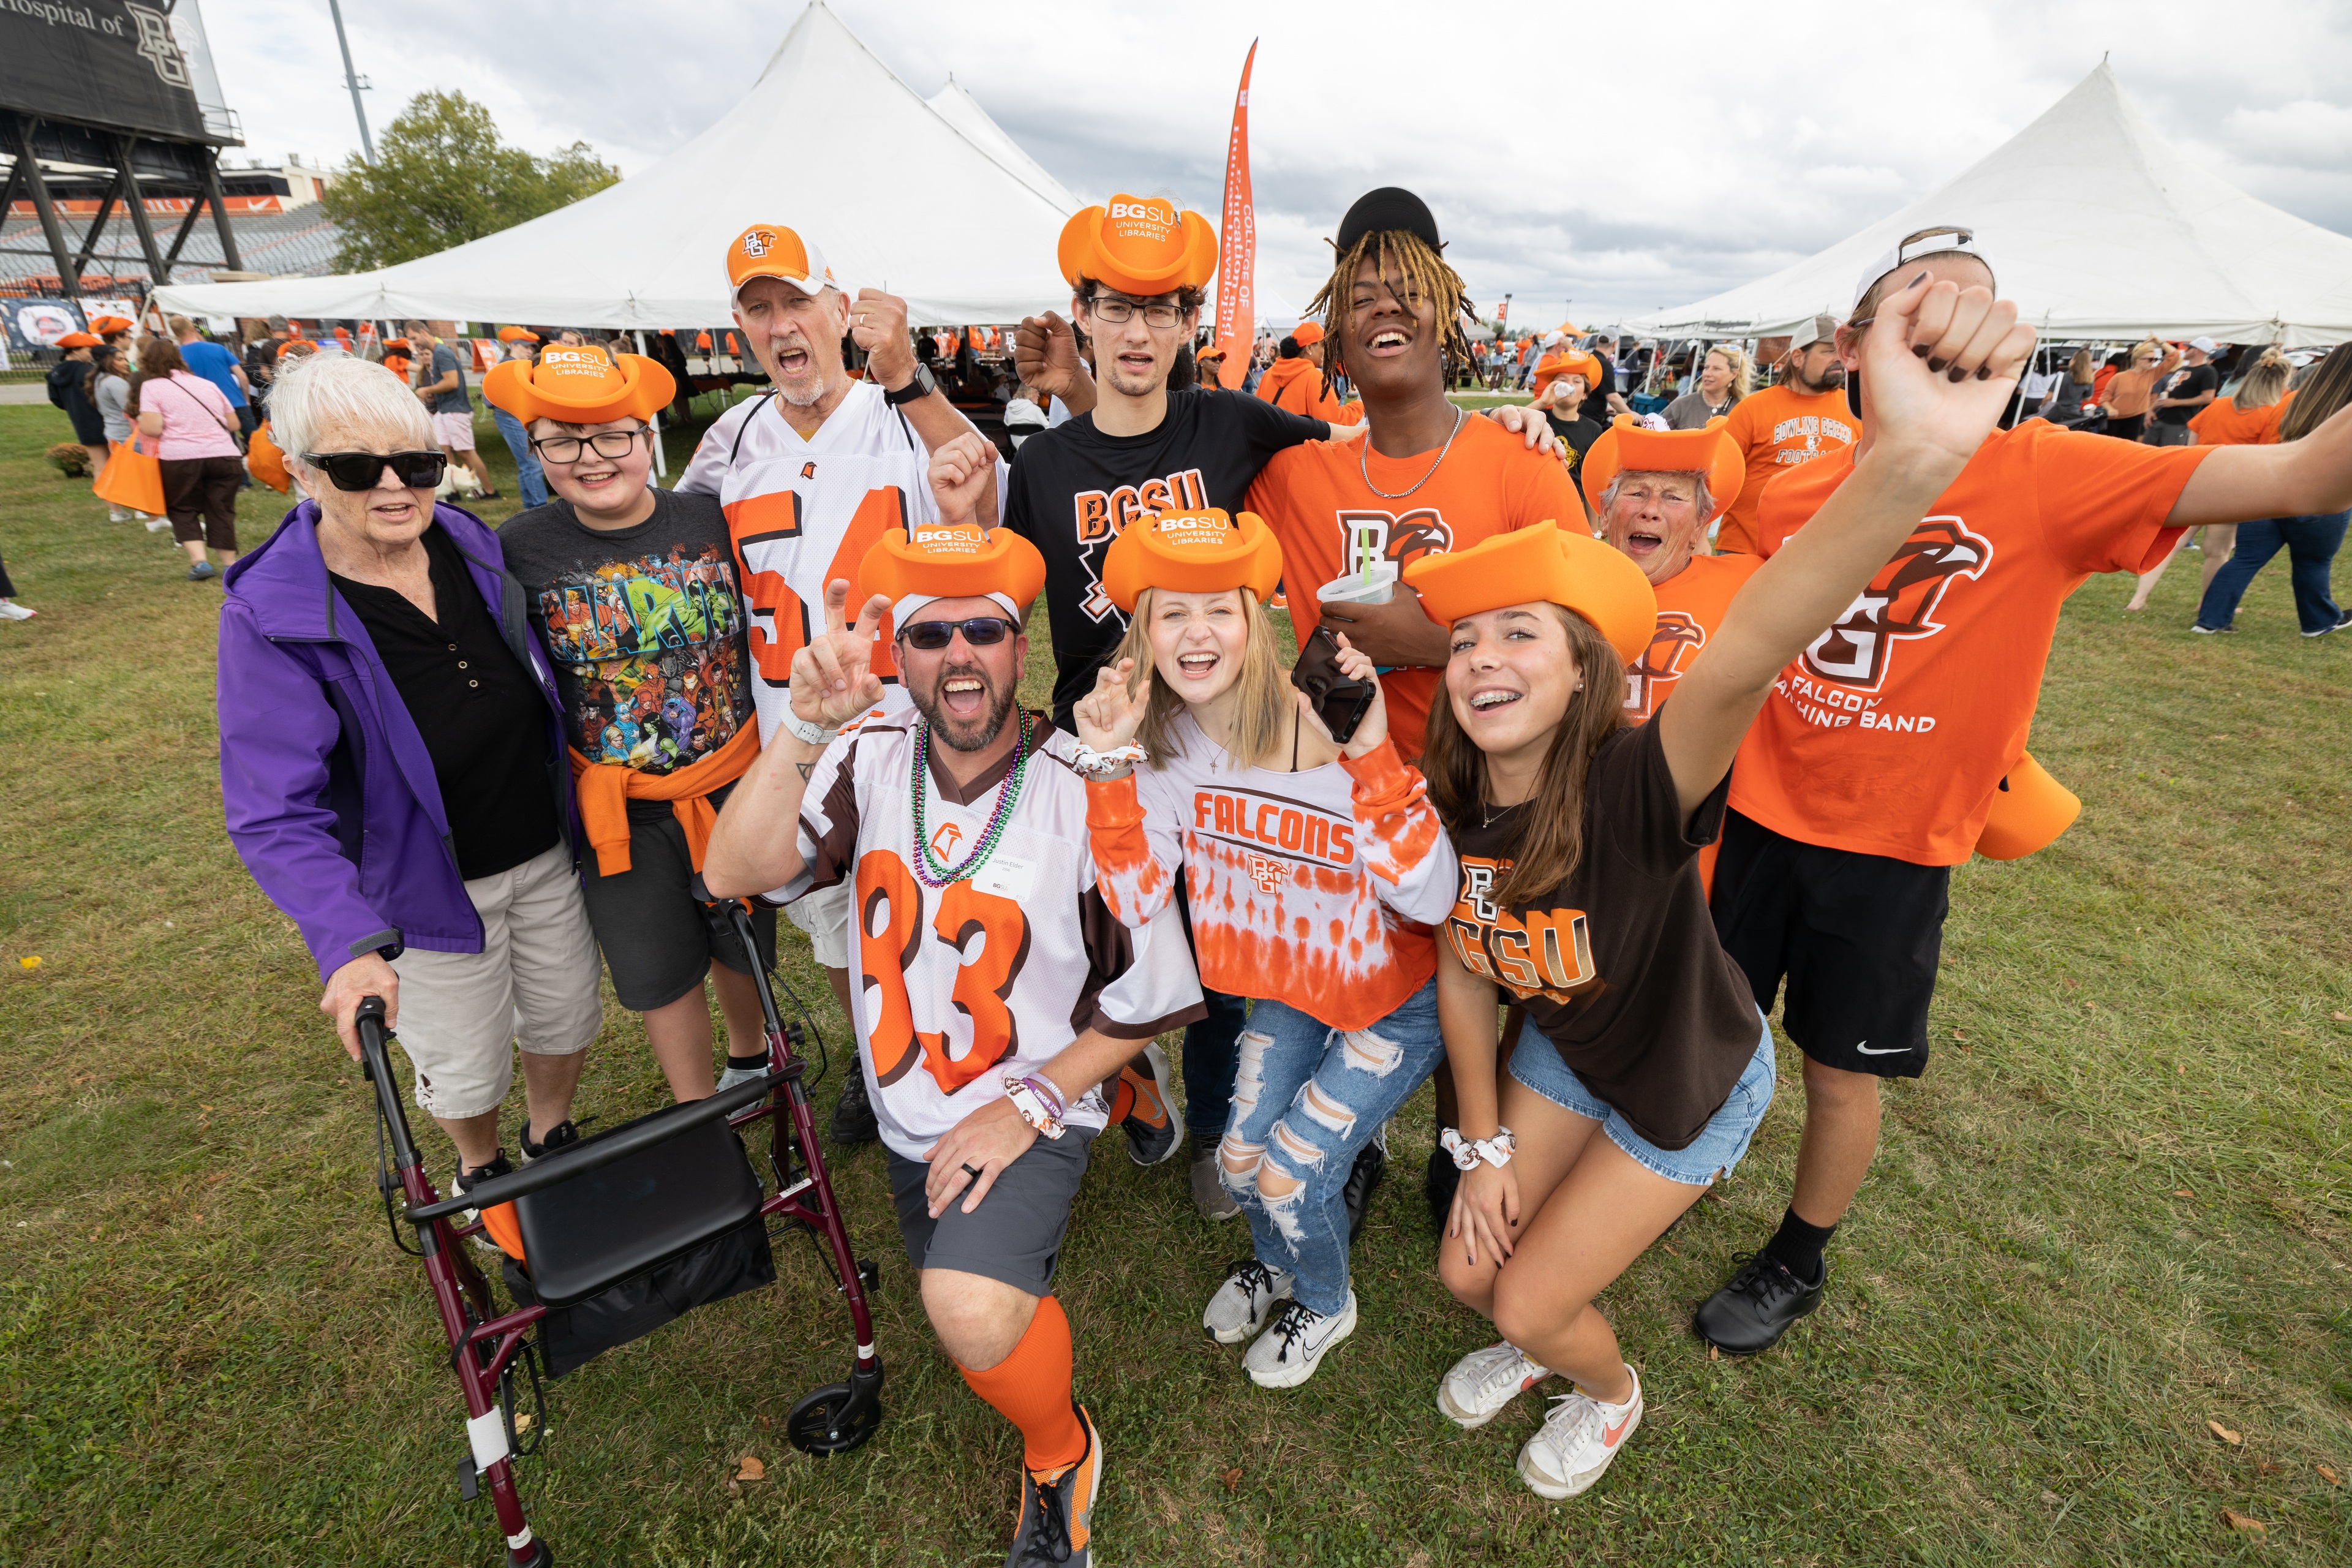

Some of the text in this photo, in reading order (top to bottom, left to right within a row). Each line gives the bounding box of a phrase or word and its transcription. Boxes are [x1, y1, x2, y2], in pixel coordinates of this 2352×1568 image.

[100, 15, 124, 37] of
[1111, 203, 1174, 225] BGSU
[1115, 221, 1170, 235] UNIVERSITY
[1119, 230, 1166, 242] LIBRARIES
[1239, 204, 1253, 308] COLLEGE OF
[1224, 294, 1235, 337] and
[545, 351, 609, 367] BGSU
[551, 363, 608, 372] UNIVERSITY
[556, 369, 605, 378] LIBRARIES
[1773, 416, 1852, 445] BOWLING GREEN
[1776, 449, 1831, 462] FOOTB
[1075, 469, 1208, 544] BGSU
[917, 530, 981, 543] BGSU
[1161, 517, 1227, 532] BGSU
[722, 485, 911, 688] 54
[539, 561, 746, 660] MARVEL
[1792, 676, 1882, 711] FALCON
[1860, 711, 1936, 733] BAND
[1194, 791, 1354, 864] FALCONS
[1441, 915, 1596, 988] GSU
[855, 849, 1031, 1096] 83
[1034, 1088, 1062, 1118] WILLY WONKA
